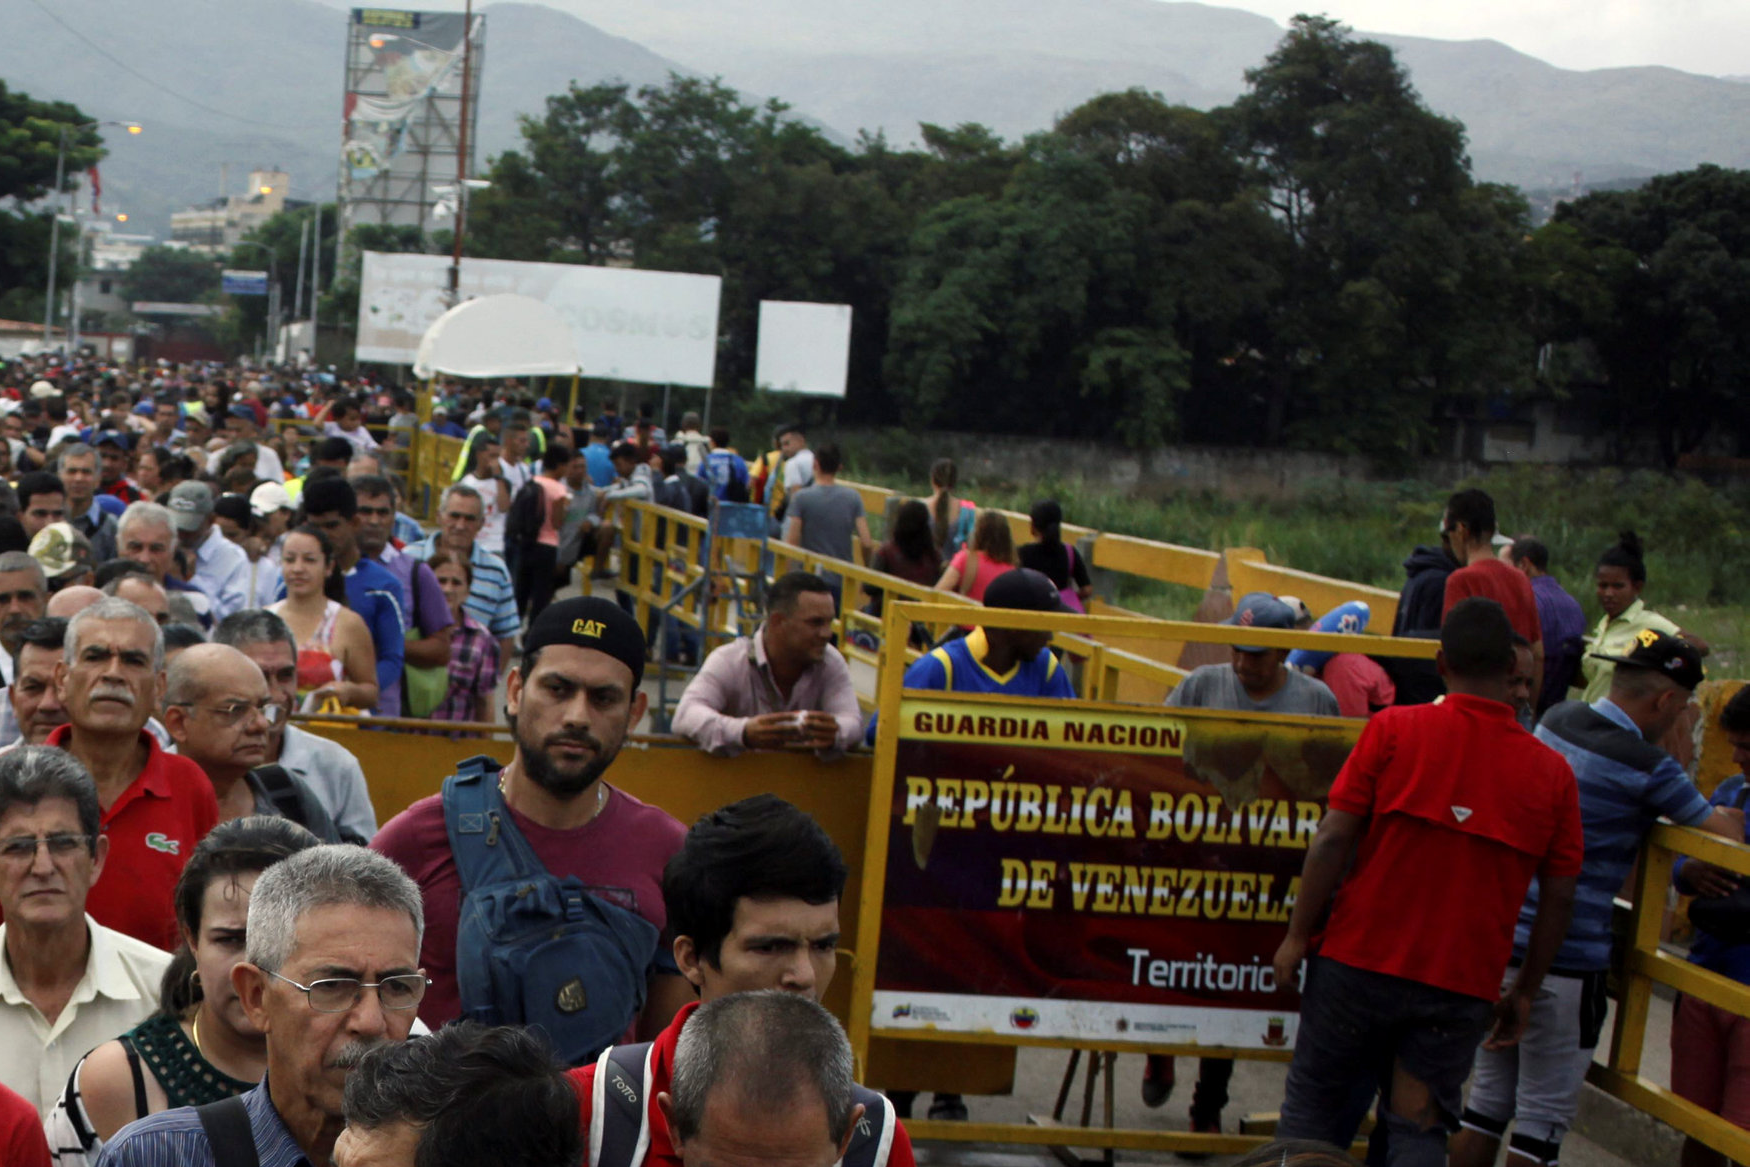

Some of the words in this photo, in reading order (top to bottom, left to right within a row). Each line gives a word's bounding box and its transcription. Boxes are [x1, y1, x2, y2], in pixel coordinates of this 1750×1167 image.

[571, 618, 607, 638] CAT
[914, 712, 1049, 740] GUARDIA
[1063, 722, 1181, 748] NACION
[902, 764, 1137, 839] REPÚBLICA
[997, 858, 1056, 910] DE
[1069, 862, 1300, 923] VENEZUELA
[1126, 948, 1277, 993] Territorio
